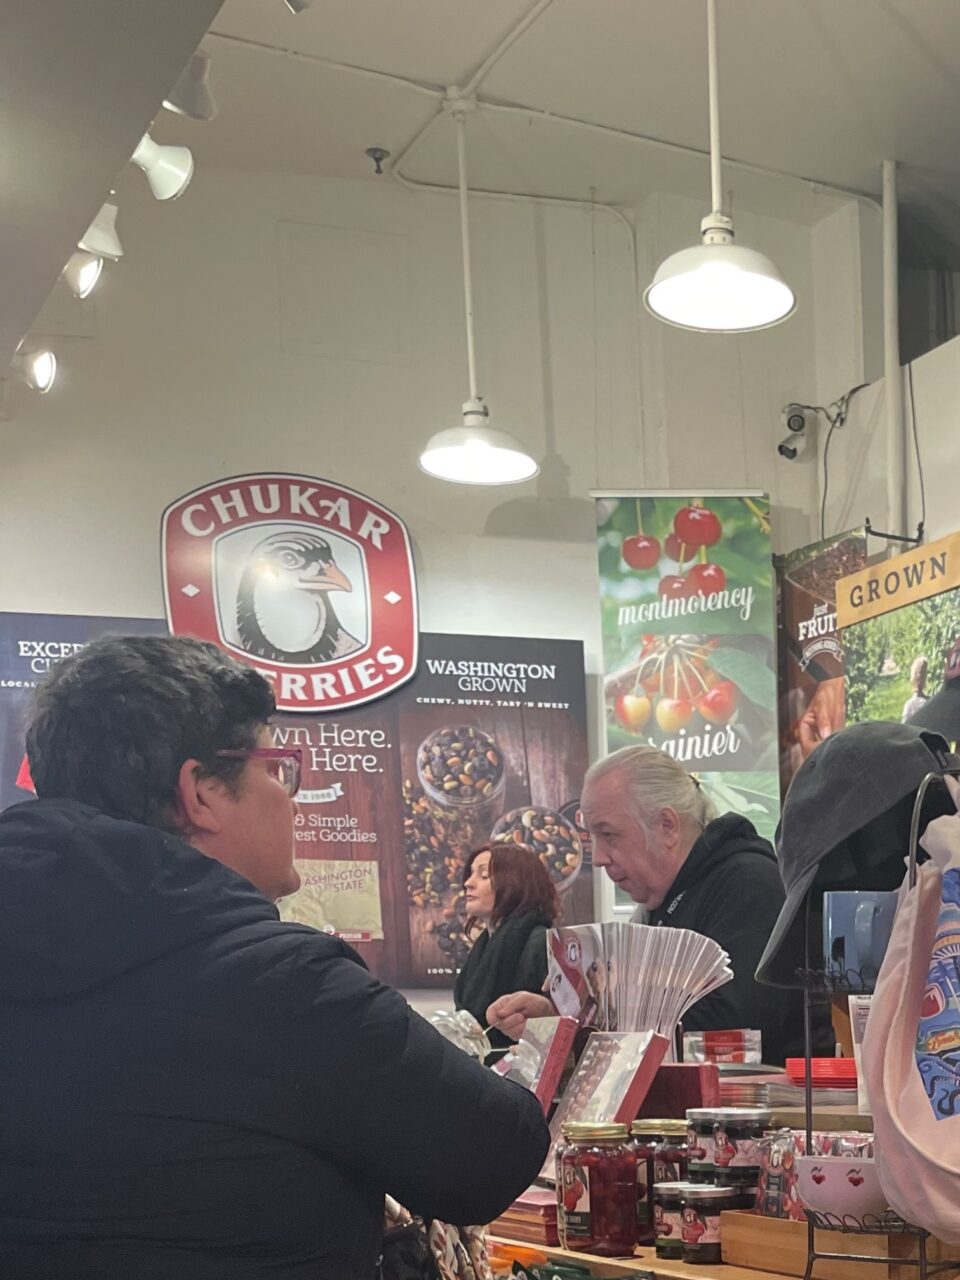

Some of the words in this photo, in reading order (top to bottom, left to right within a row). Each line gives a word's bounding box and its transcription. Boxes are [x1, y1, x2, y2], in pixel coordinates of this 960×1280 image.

[181, 484, 391, 551] CHUKAR
[849, 558, 948, 609] GROWN
[618, 586, 754, 626] montmorency
[17, 640, 89, 658] EXCEP
[259, 645, 405, 701] RRIES
[426, 659, 556, 679] WASHINGTON
[458, 676, 527, 693] GROWN
[416, 697, 455, 705] CHEWY,
[457, 698, 493, 707] NUTTY,
[317, 722, 392, 749] Here.
[648, 724, 741, 762] ainier
[309, 747, 384, 773] Here.
[308, 813, 358, 831] Simple
[319, 829, 377, 842] Goodies
[300, 868, 372, 888] ASHINGTON
[333, 879, 365, 893] STATE
